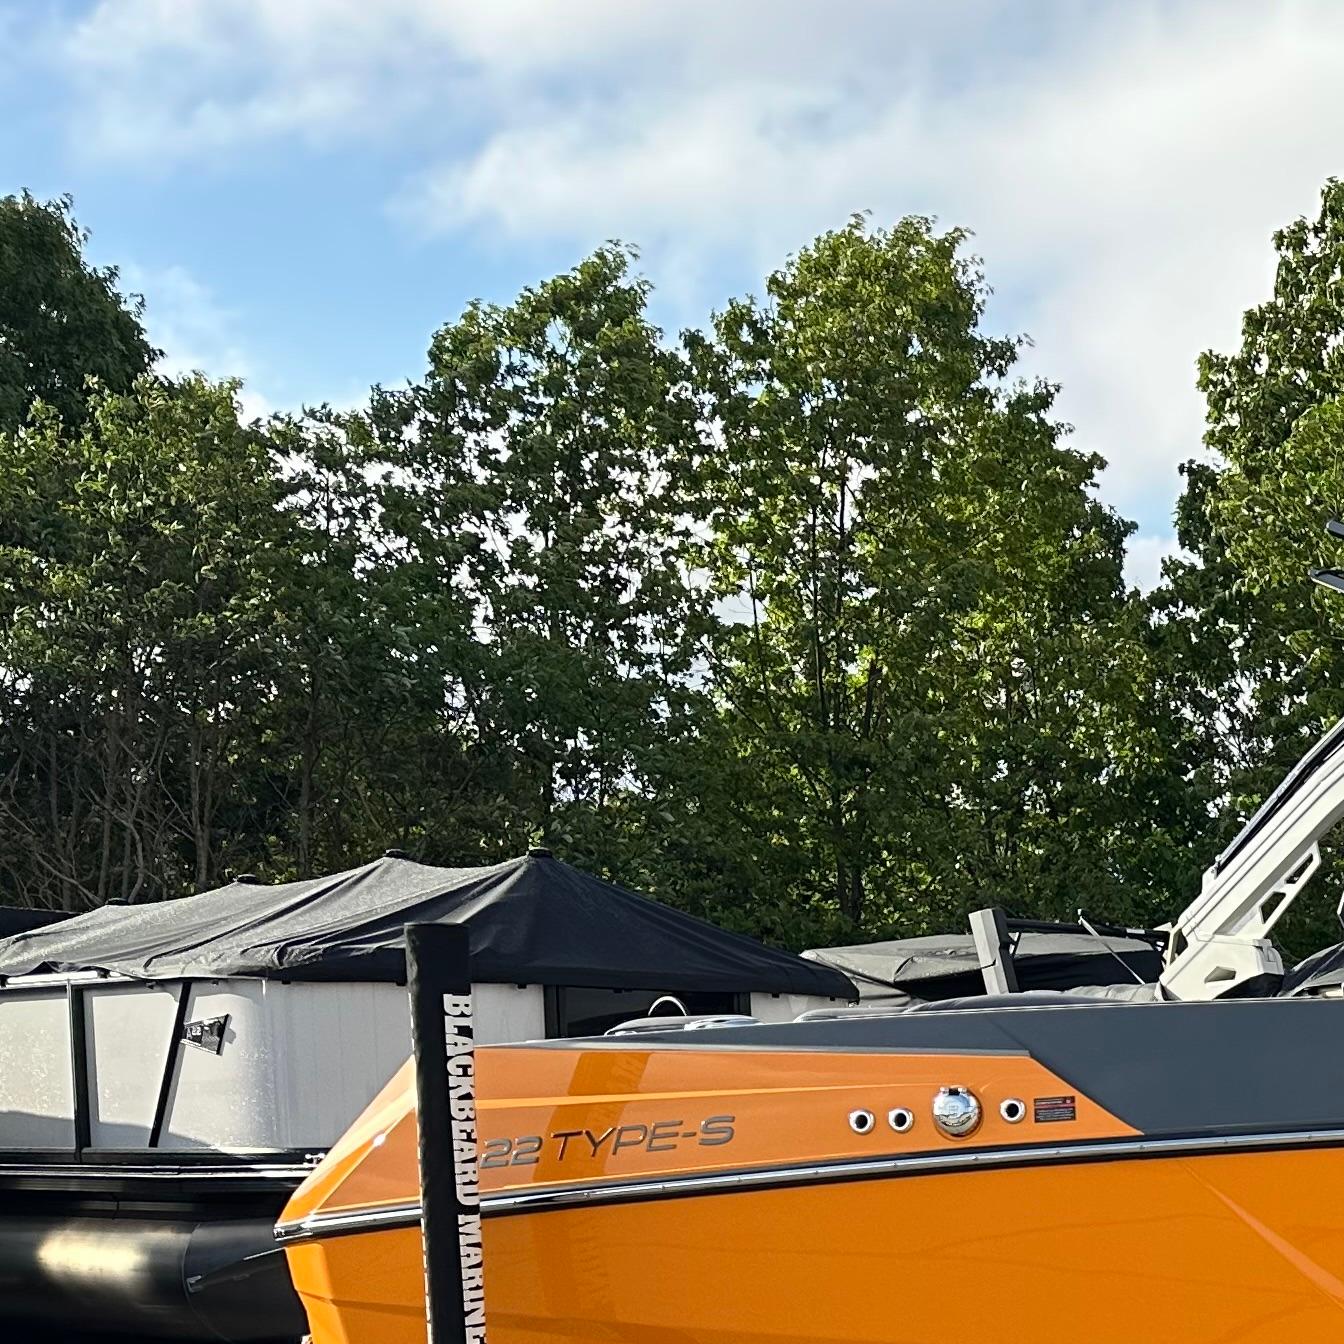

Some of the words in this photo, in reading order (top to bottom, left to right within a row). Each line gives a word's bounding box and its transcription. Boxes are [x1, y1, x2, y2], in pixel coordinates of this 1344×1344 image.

[443, 994, 480, 1206] BLACKBEARD
[480, 1136, 543, 1169] 22
[551, 1115, 735, 1161] TYPE-S
